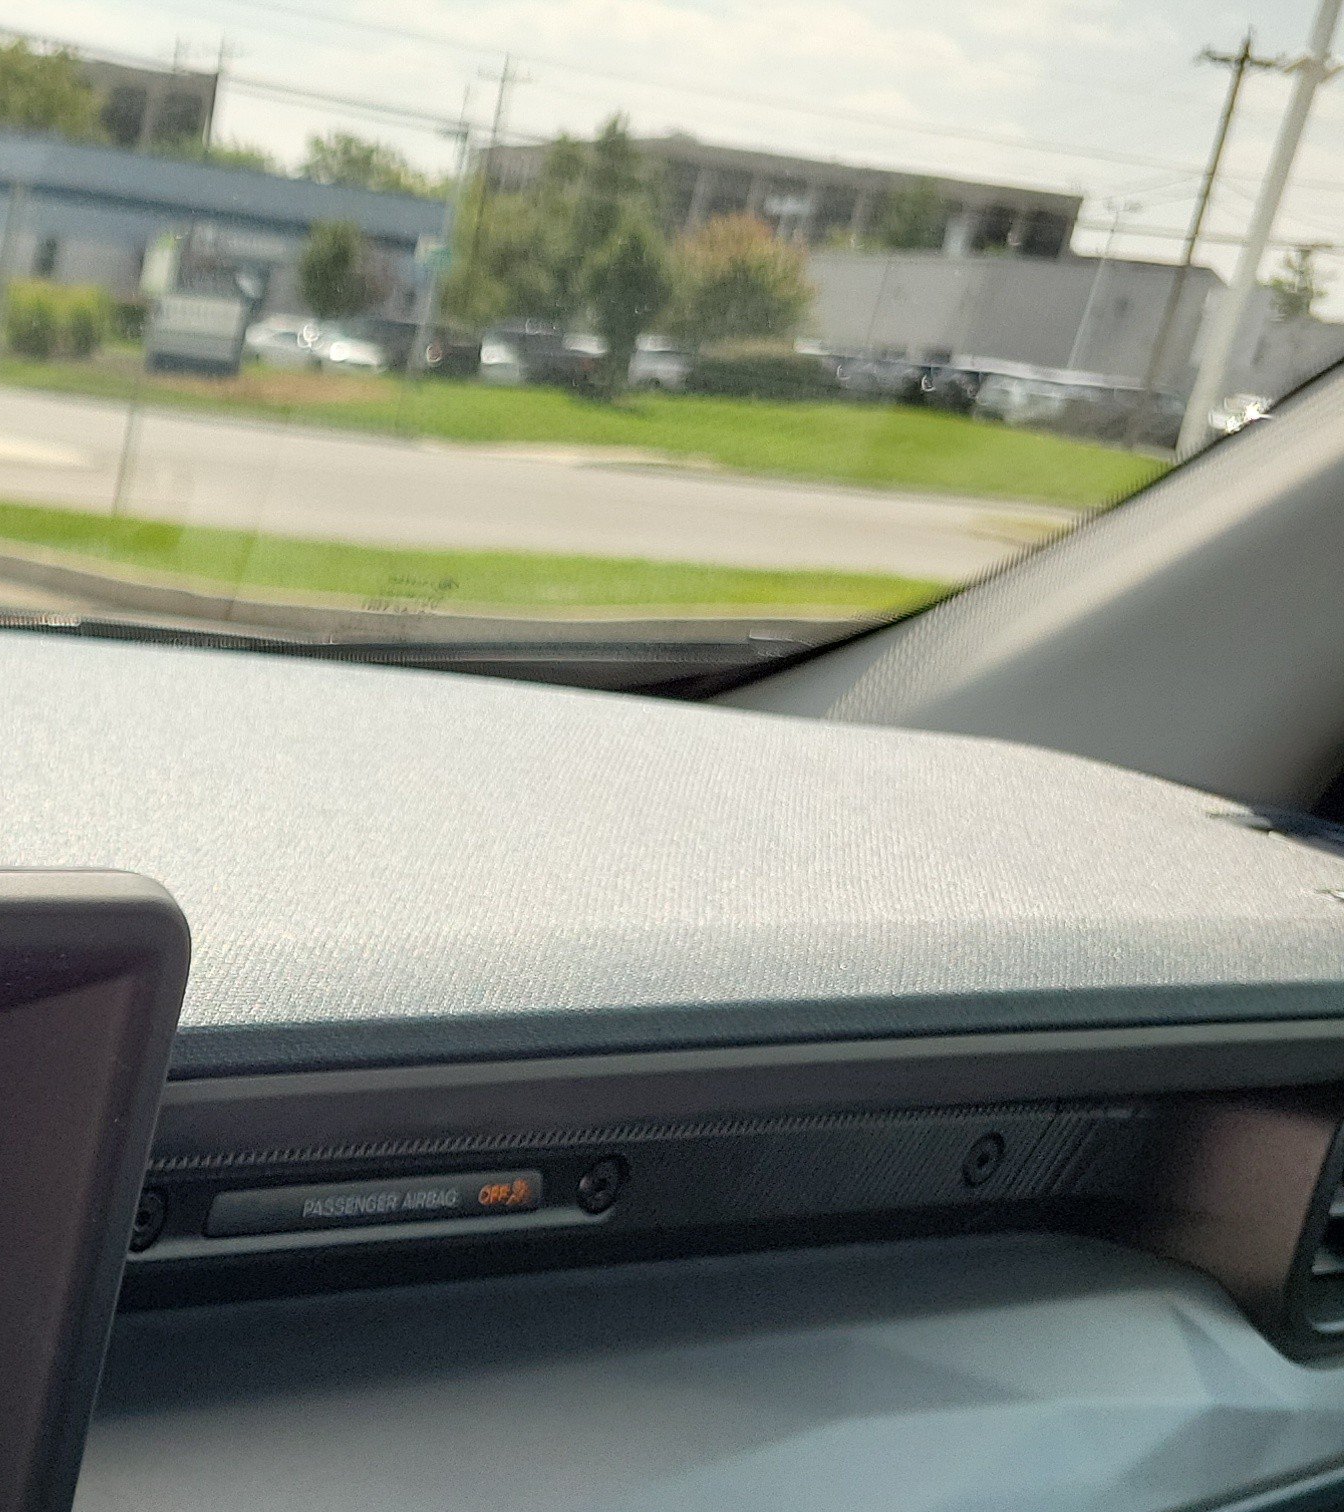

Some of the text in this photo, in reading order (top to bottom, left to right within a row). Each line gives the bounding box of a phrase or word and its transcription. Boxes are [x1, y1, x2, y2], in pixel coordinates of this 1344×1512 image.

[302, 1183, 511, 1218] PASSENGER AIRBAG OFF
